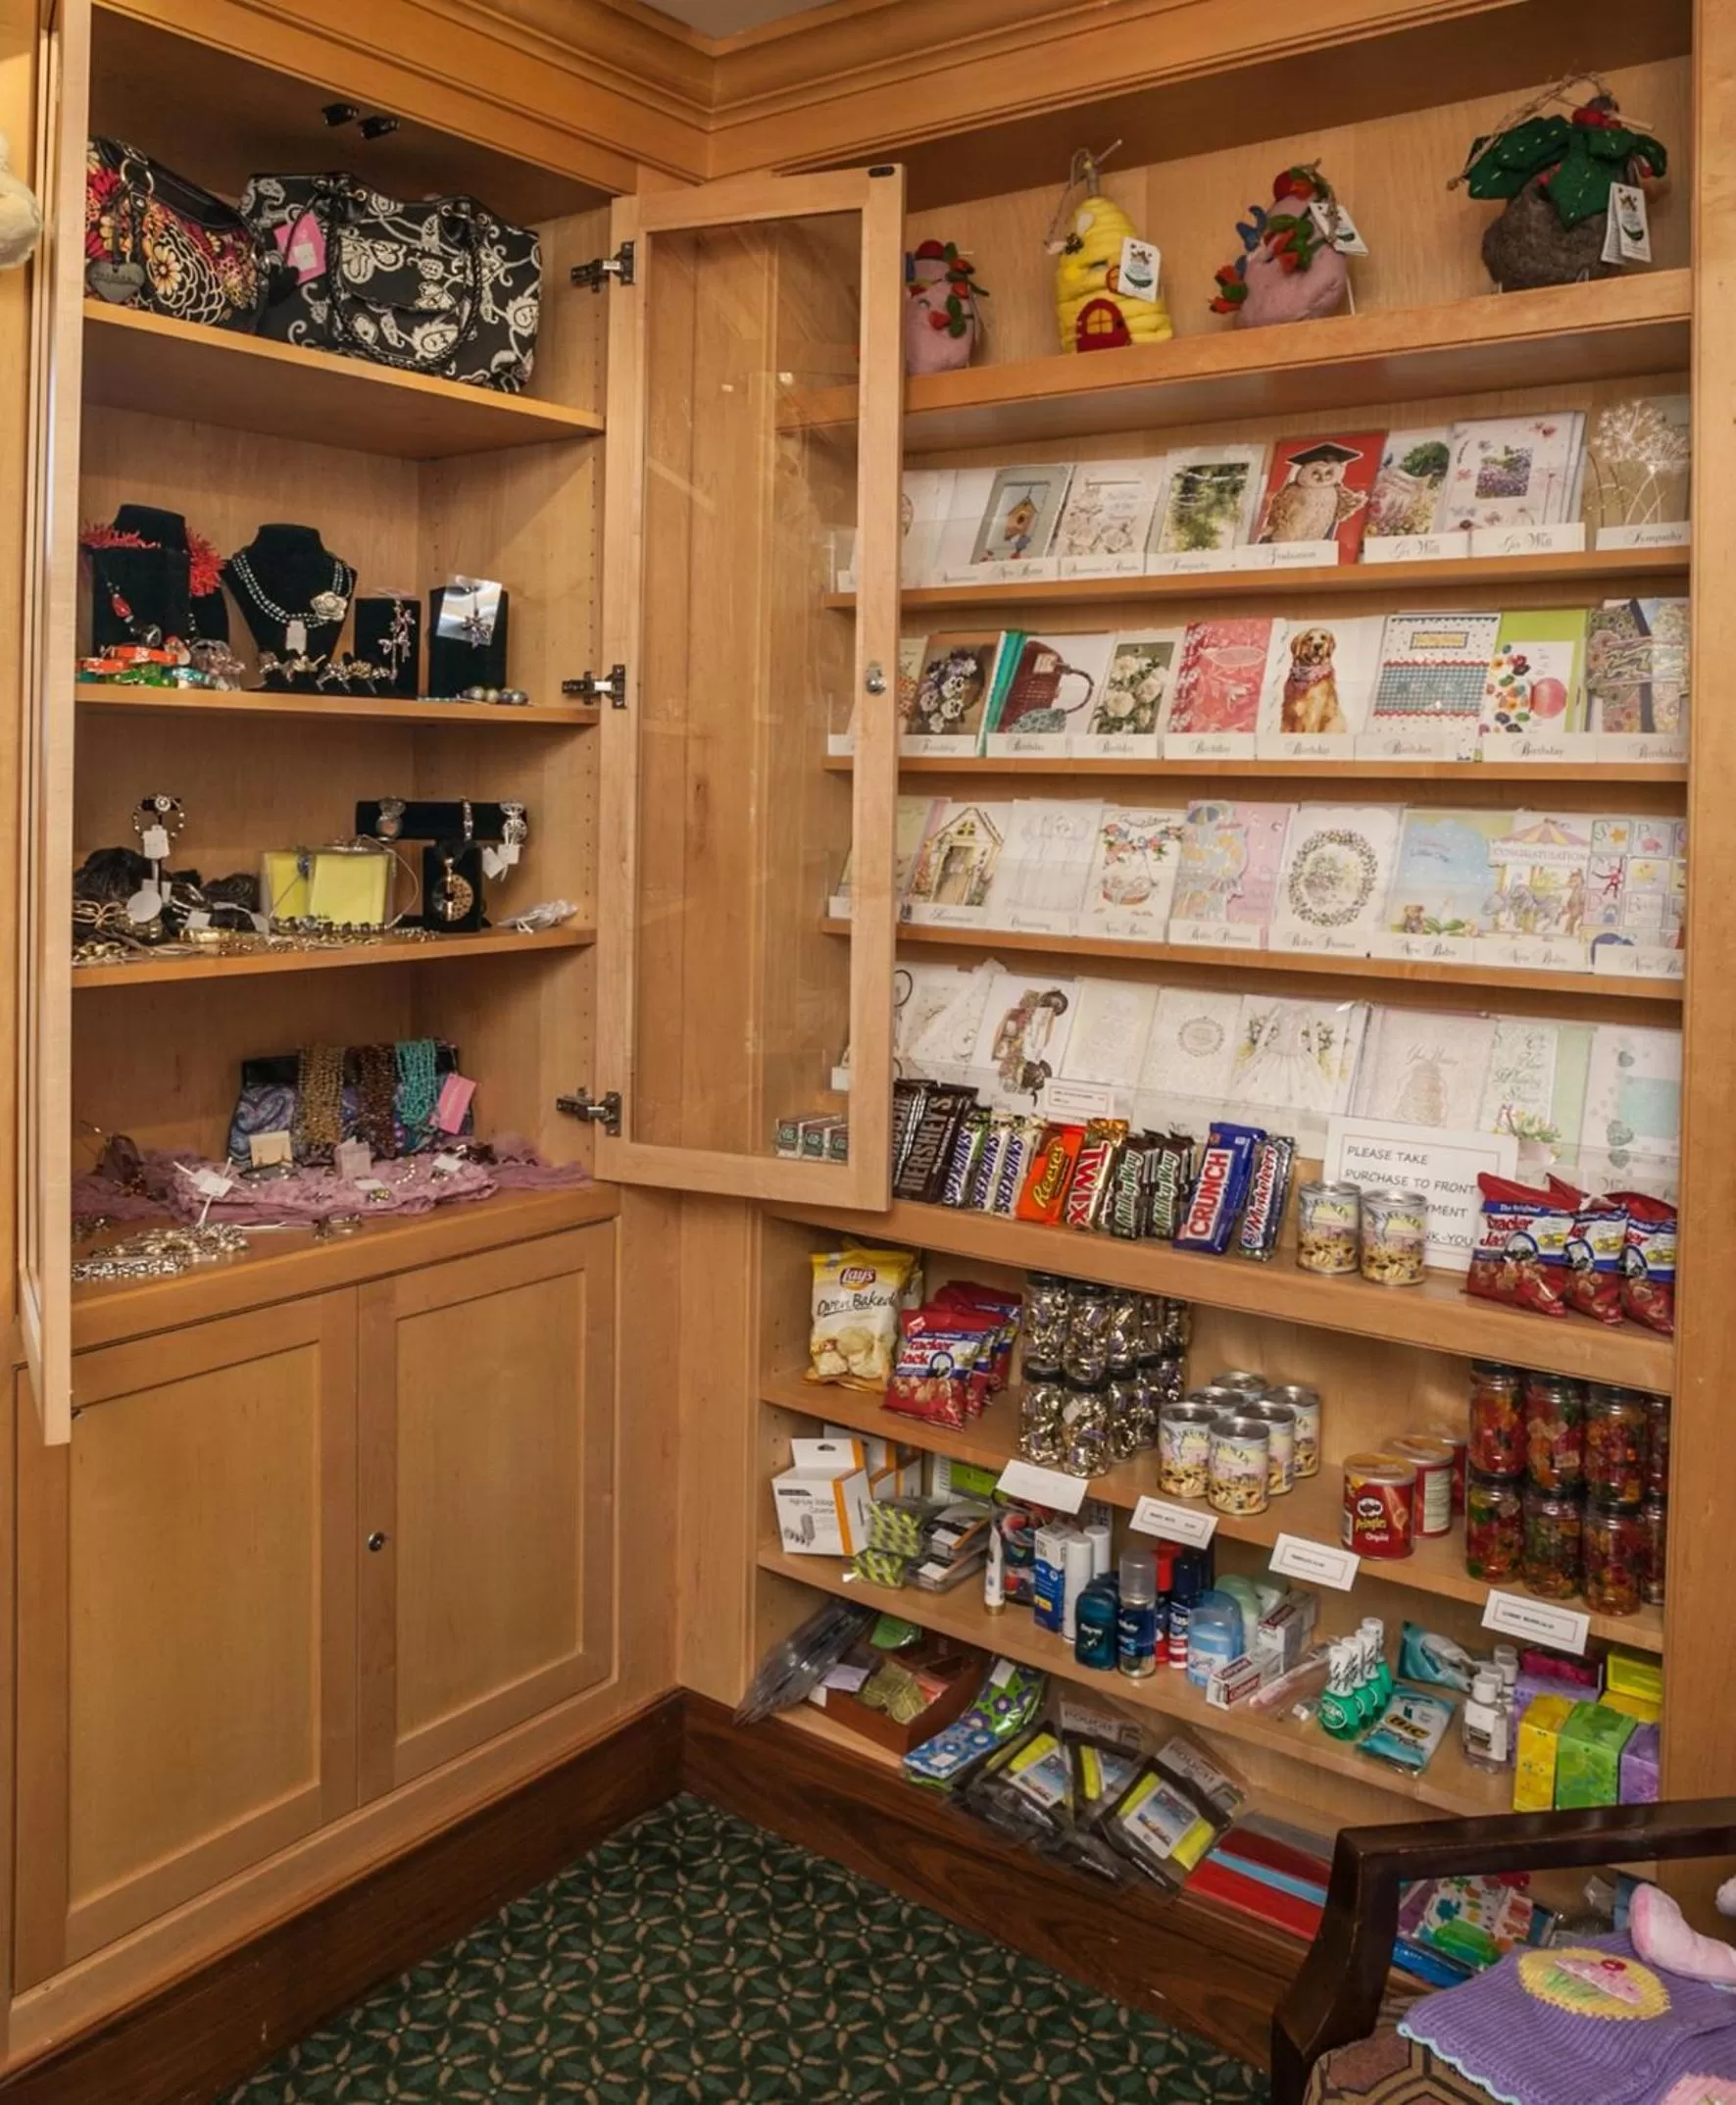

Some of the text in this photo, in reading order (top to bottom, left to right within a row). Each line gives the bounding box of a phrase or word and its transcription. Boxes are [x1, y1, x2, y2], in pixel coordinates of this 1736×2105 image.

[901, 1097, 954, 1192] HERSHEY'S
[1347, 1145, 1428, 1166] PLEASE TAKE
[1066, 1139, 1112, 1227] TWIX
[1187, 1151, 1230, 1236] CRUNCH
[1345, 1169, 1477, 1195] PURCHASE TO FRONT
[1424, 1204, 1468, 1219] YMENT
[853, 1290, 896, 1309] Baked
[1388, 1717, 1427, 1739] BIC
